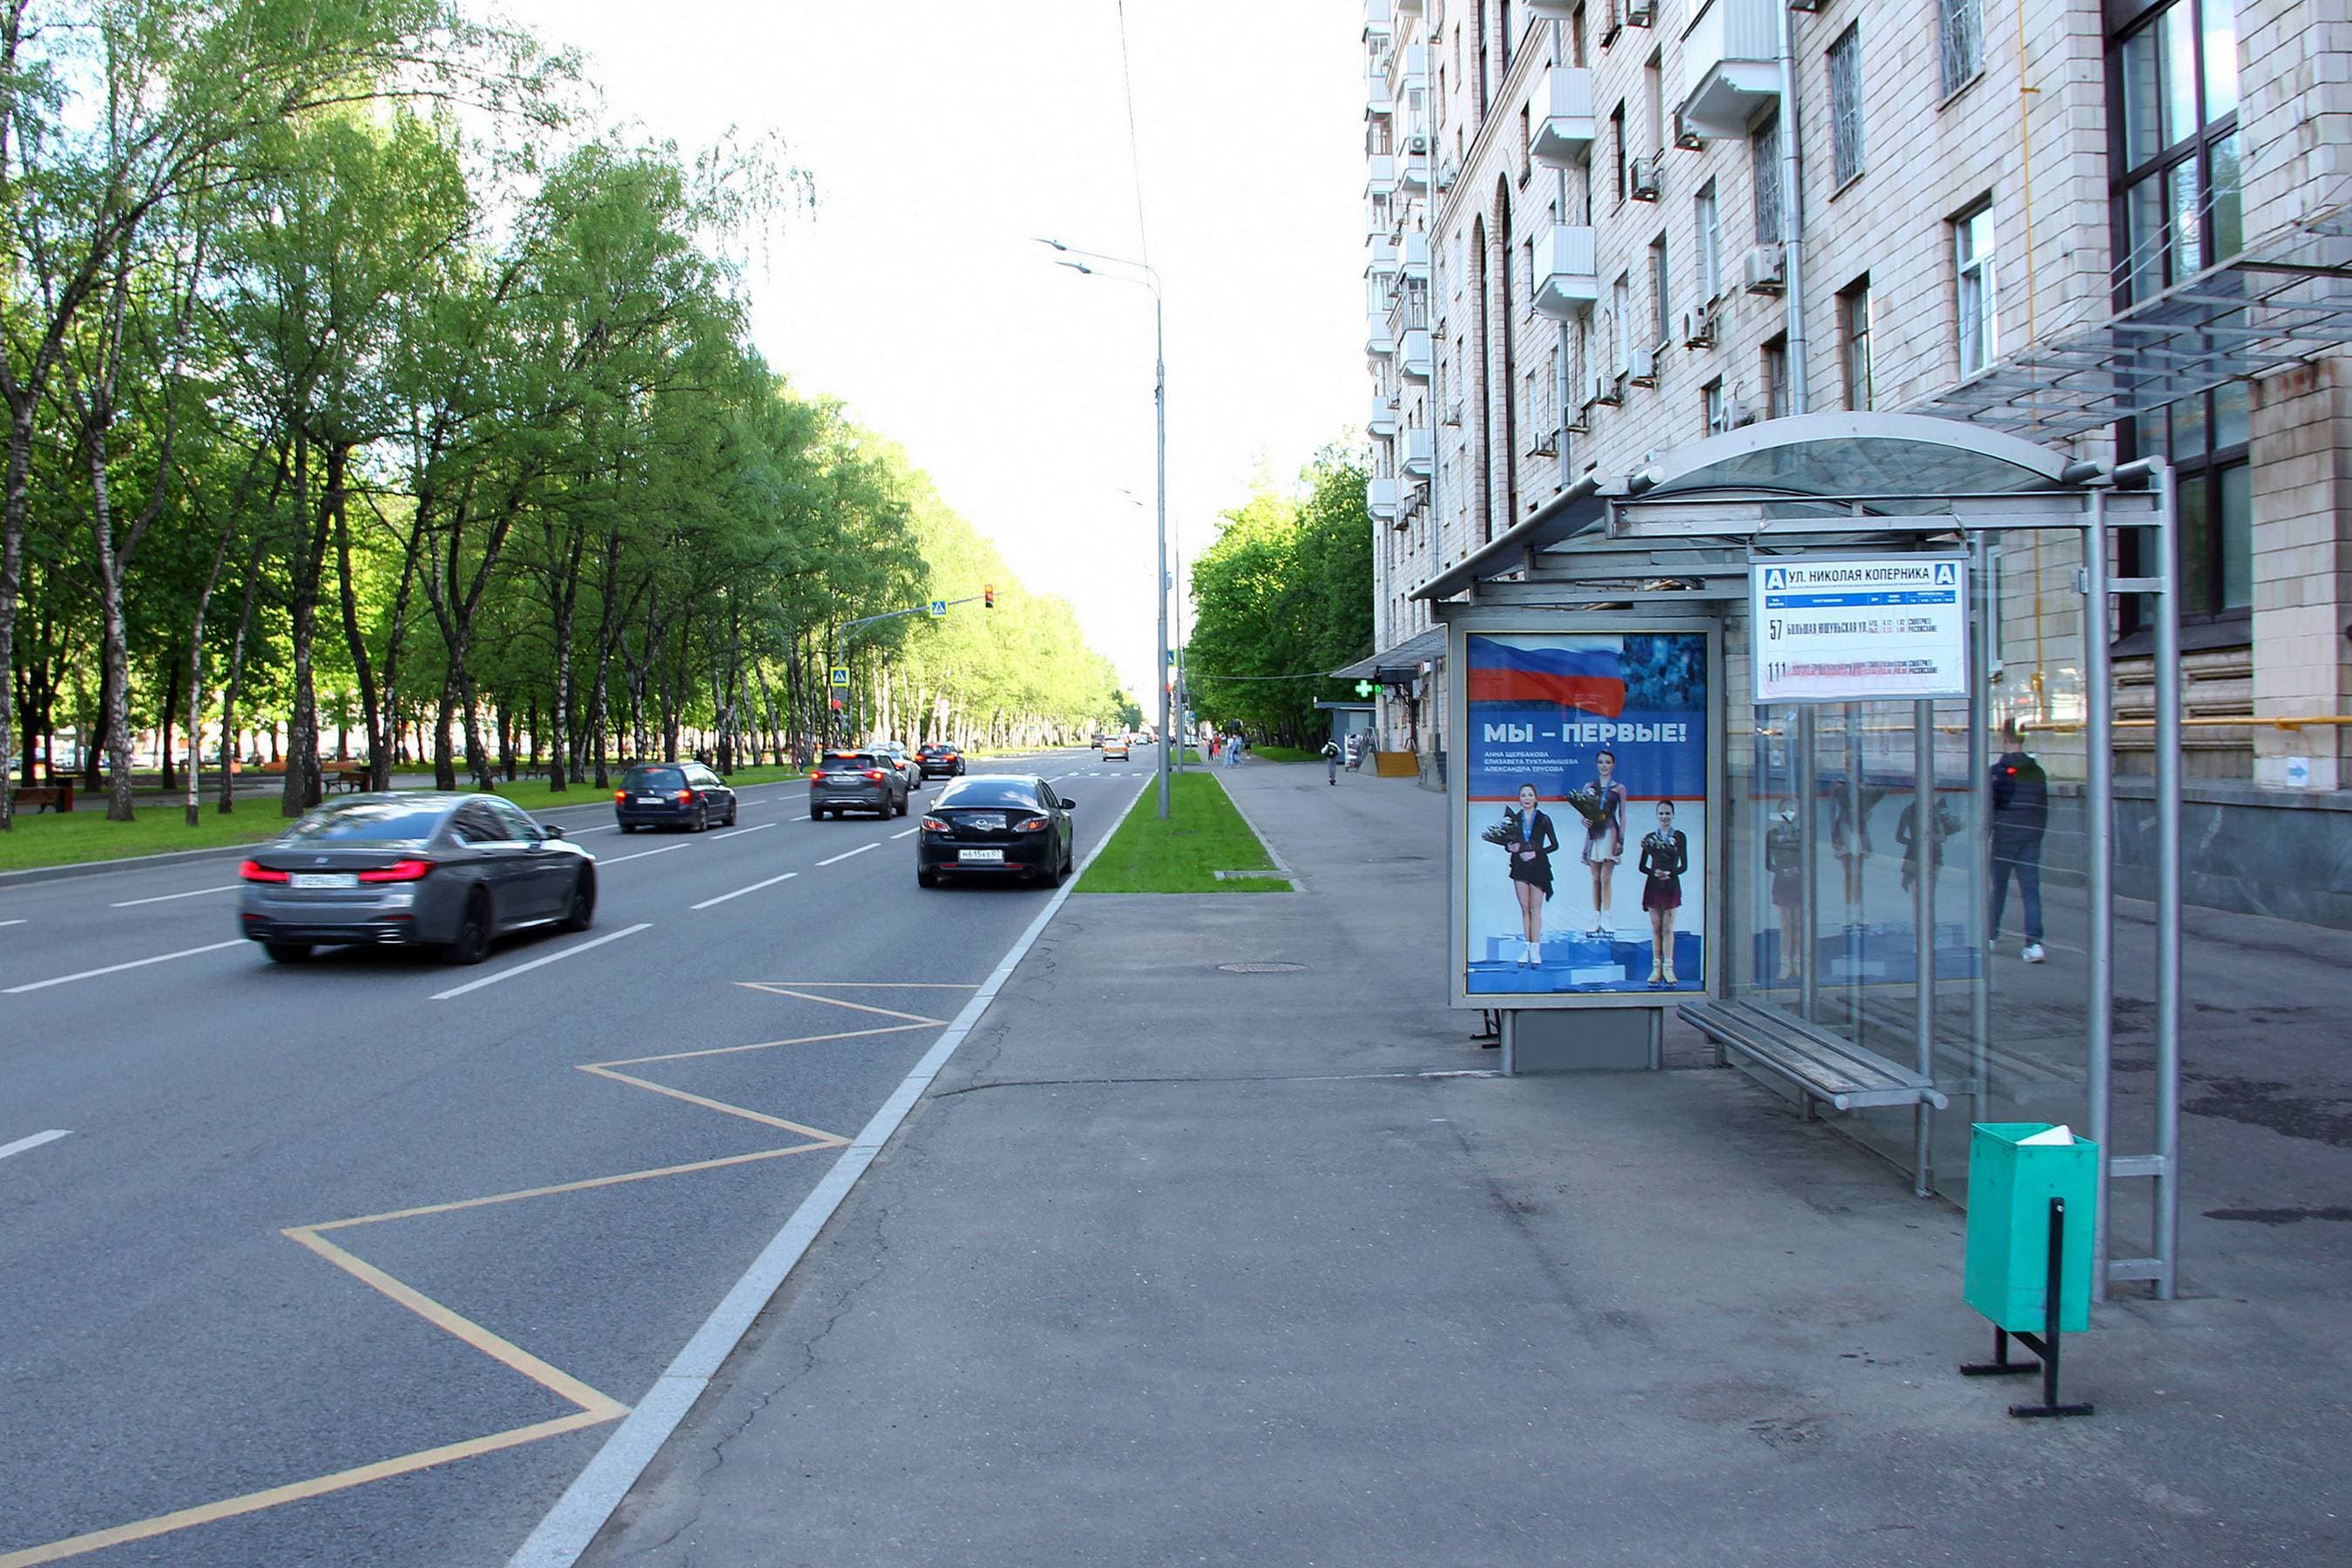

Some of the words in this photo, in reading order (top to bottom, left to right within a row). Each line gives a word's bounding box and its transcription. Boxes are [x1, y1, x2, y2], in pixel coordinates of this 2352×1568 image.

[1788, 571, 1807, 583] УЛ.
[1809, 570, 1862, 582] НИКОЛАЯ
[1865, 567, 1930, 581] КОПЕРНИКА
[1770, 619, 1782, 639] 57
[1768, 661, 1786, 682] 111
[1484, 723, 1533, 742] МЫ
[1563, 723, 1686, 742] ПЕРВЫЕ!
